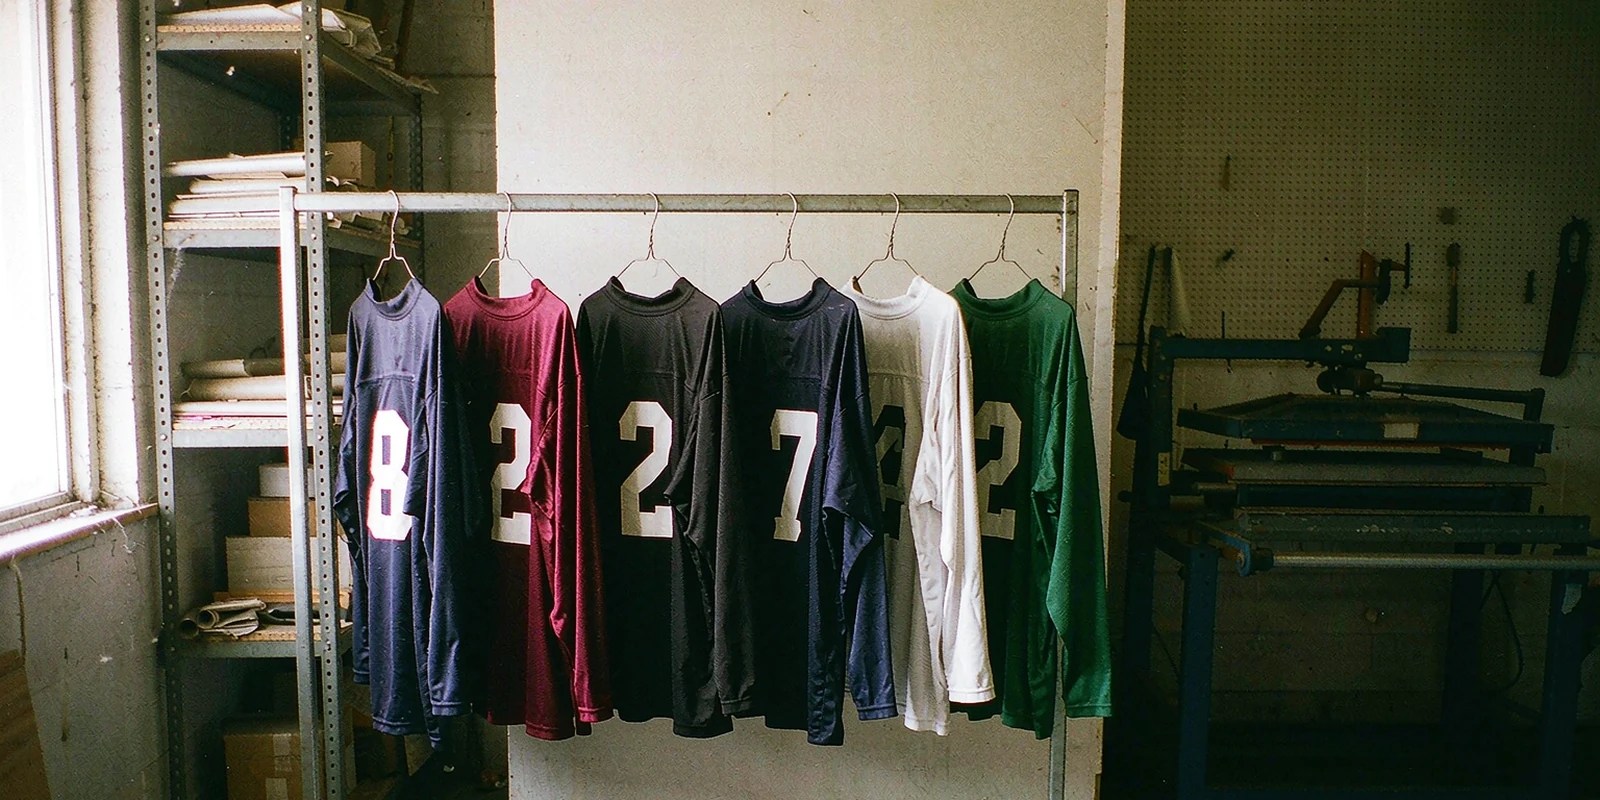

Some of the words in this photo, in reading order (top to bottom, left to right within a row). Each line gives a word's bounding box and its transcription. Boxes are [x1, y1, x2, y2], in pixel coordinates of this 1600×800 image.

[366, 409, 412, 541] 8
[489, 402, 531, 546] 2
[619, 401, 673, 538] 2
[770, 409, 818, 542] 7
[974, 401, 1022, 541] 2
